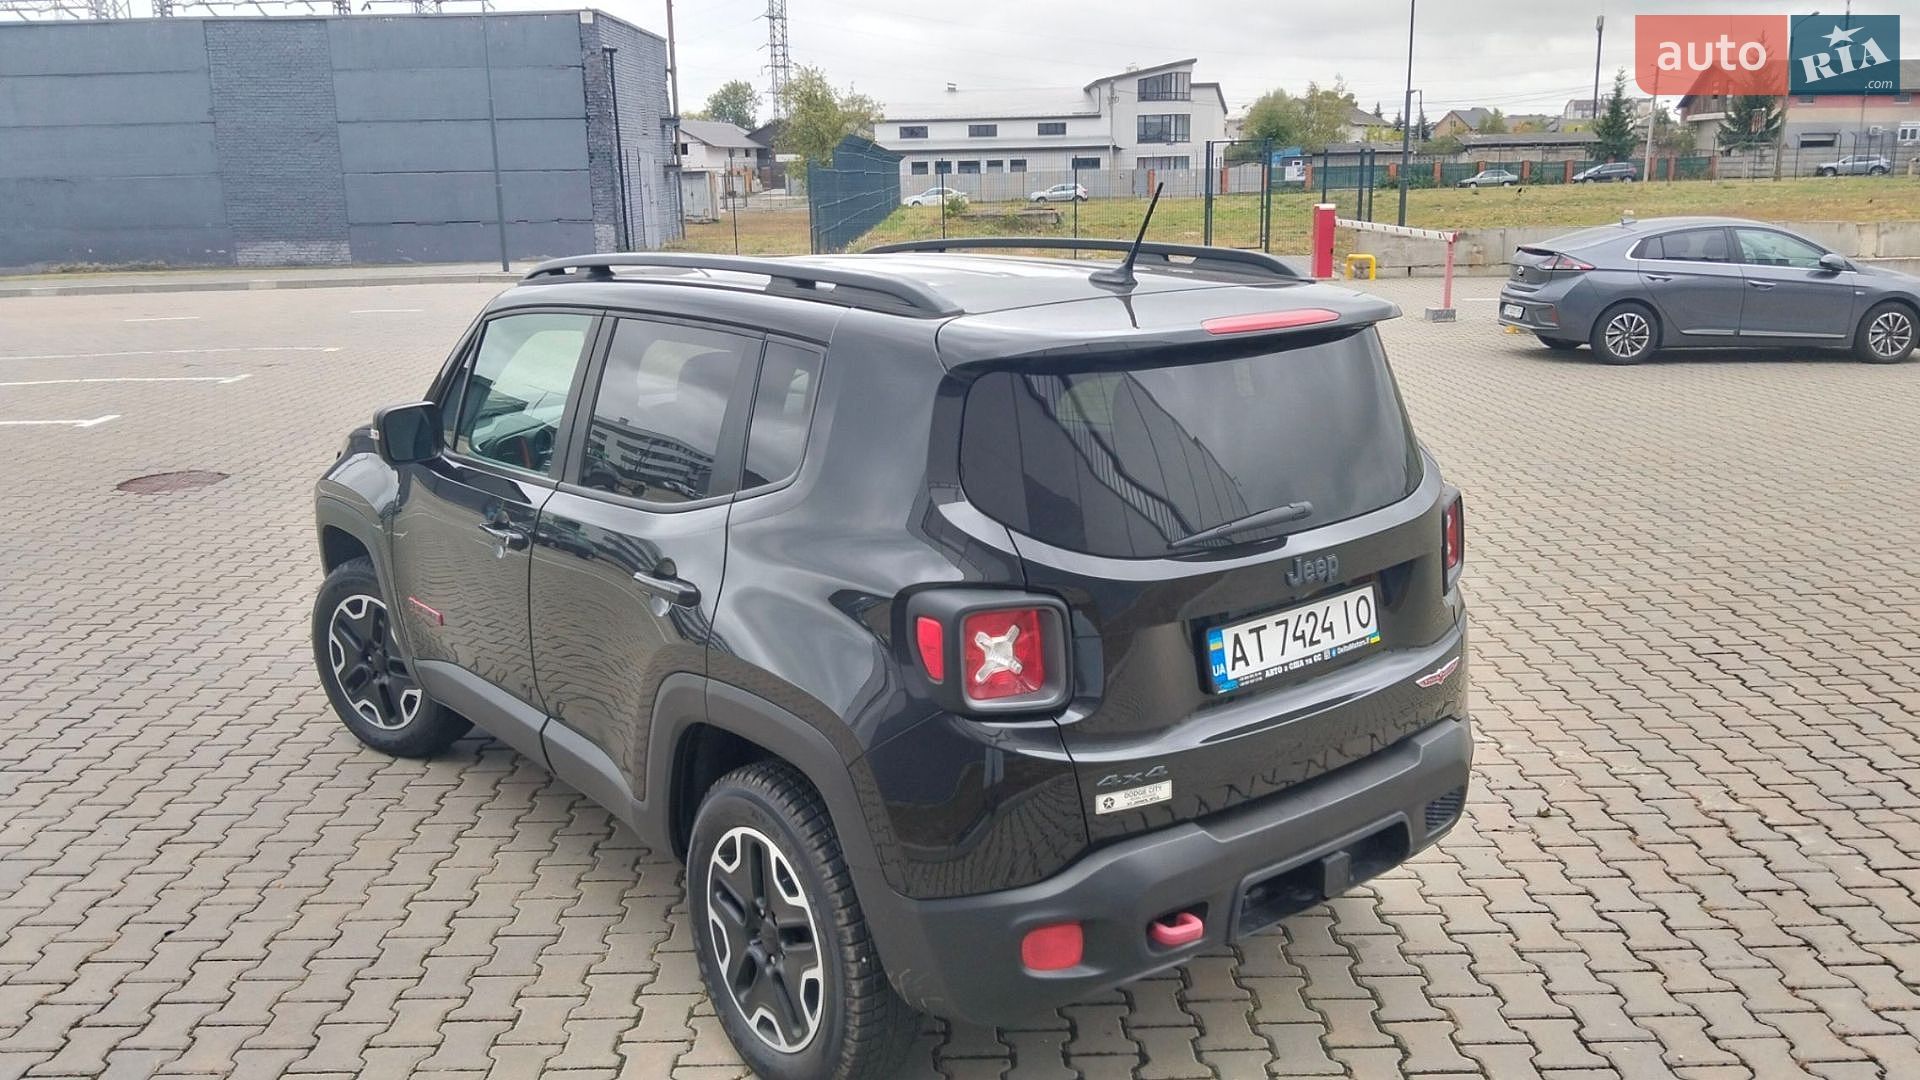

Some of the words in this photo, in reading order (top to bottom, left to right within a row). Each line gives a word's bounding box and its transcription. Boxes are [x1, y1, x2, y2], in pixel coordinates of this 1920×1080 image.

[1285, 554, 1339, 587] Jeep
[1231, 624, 1267, 671] AT
[1275, 606, 1335, 657] 7424
[1212, 663, 1226, 677] UA
